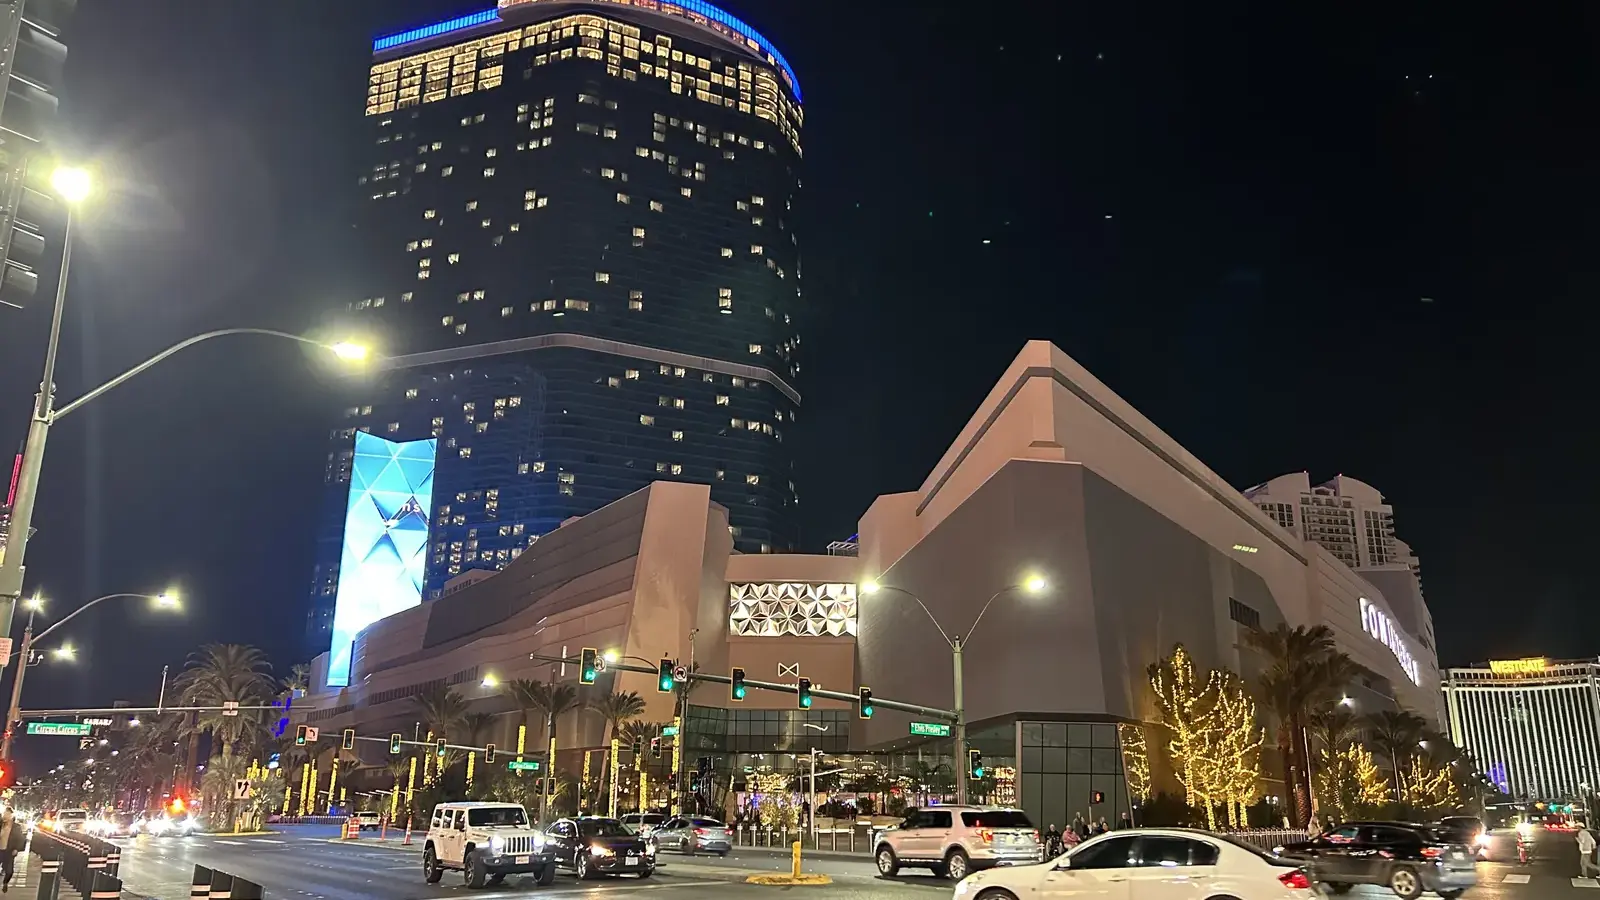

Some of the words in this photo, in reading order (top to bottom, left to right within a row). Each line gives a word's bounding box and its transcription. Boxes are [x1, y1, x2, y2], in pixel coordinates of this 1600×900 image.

[1490, 659, 1544, 674] WESTGATE
[35, 724, 57, 734] Circus
[57, 725, 79, 735] Circus
[915, 723, 926, 732] Elvis
[925, 724, 941, 735] Presley
